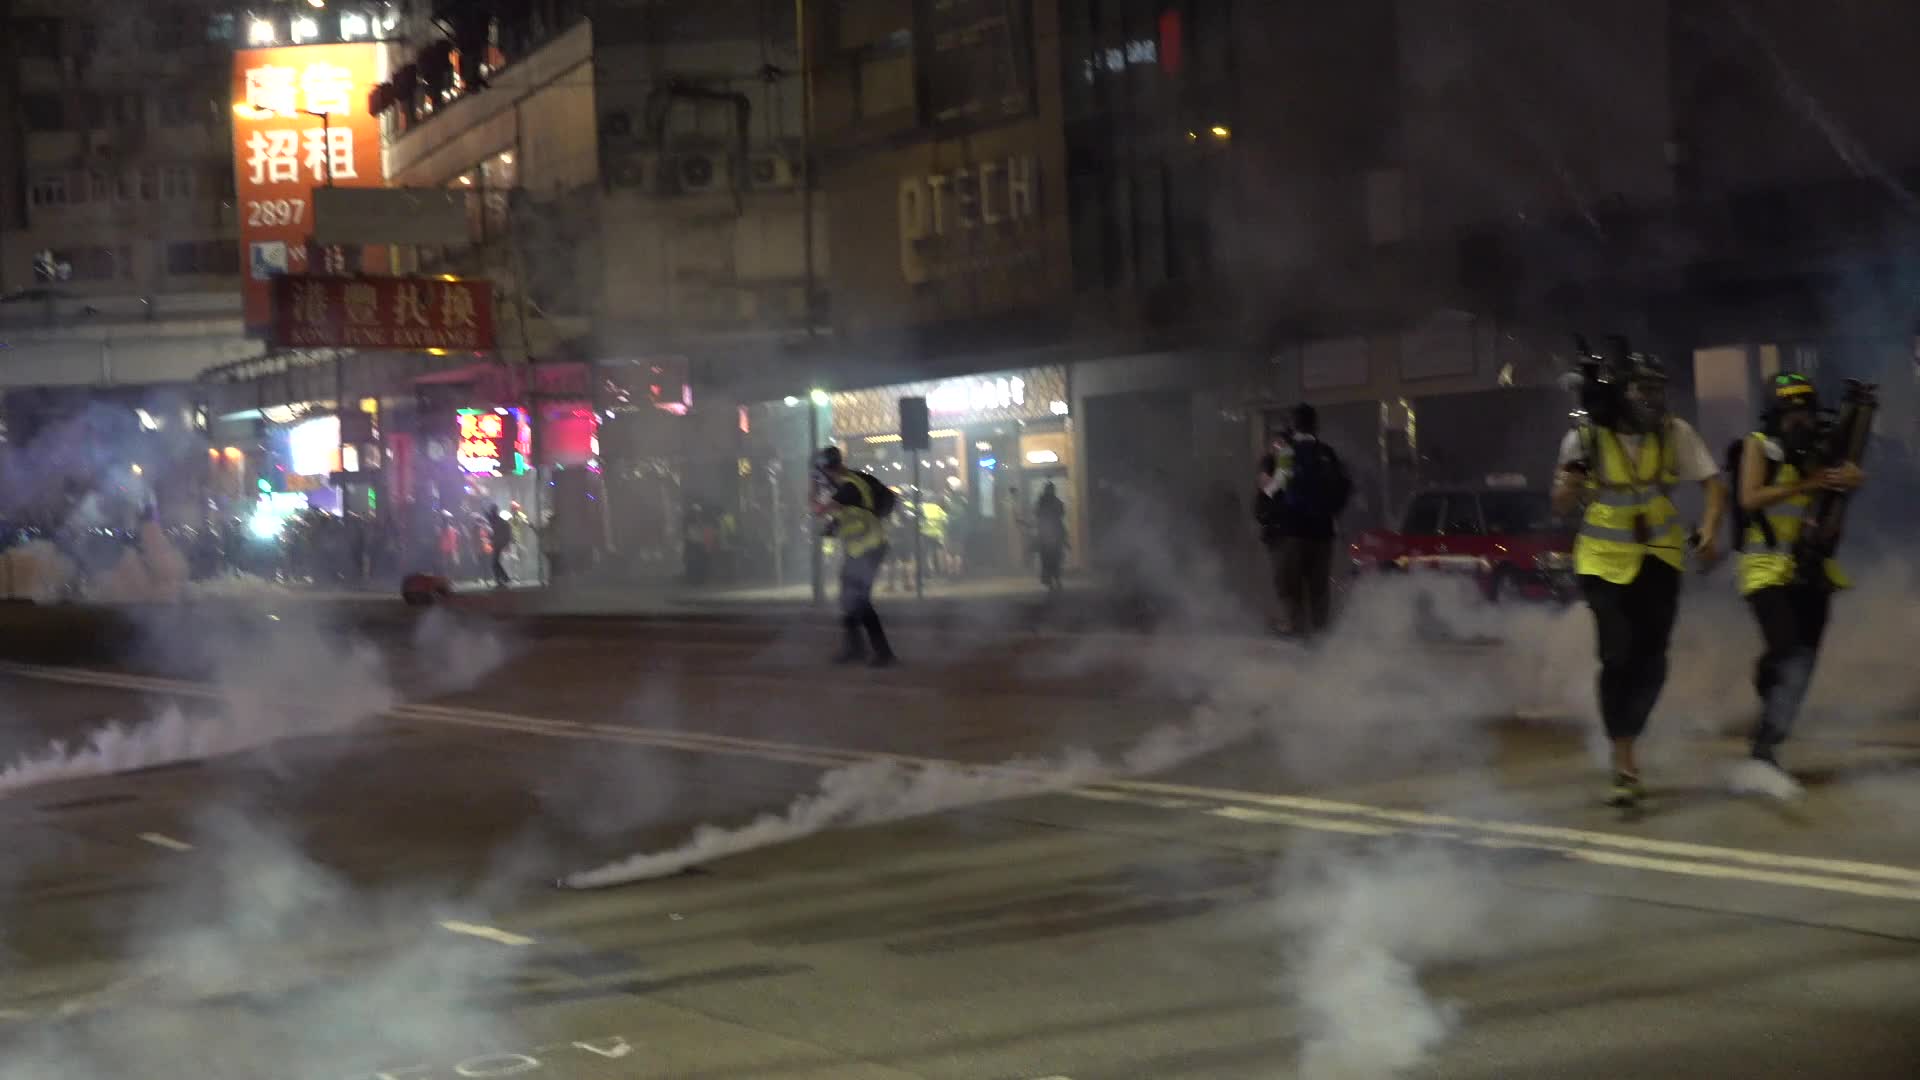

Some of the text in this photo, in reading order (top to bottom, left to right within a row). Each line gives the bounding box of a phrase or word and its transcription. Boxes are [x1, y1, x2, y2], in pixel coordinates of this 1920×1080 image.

[245, 60, 354, 119] 廣告
[246, 127, 357, 184] 招租
[248, 199, 305, 226] 2897
